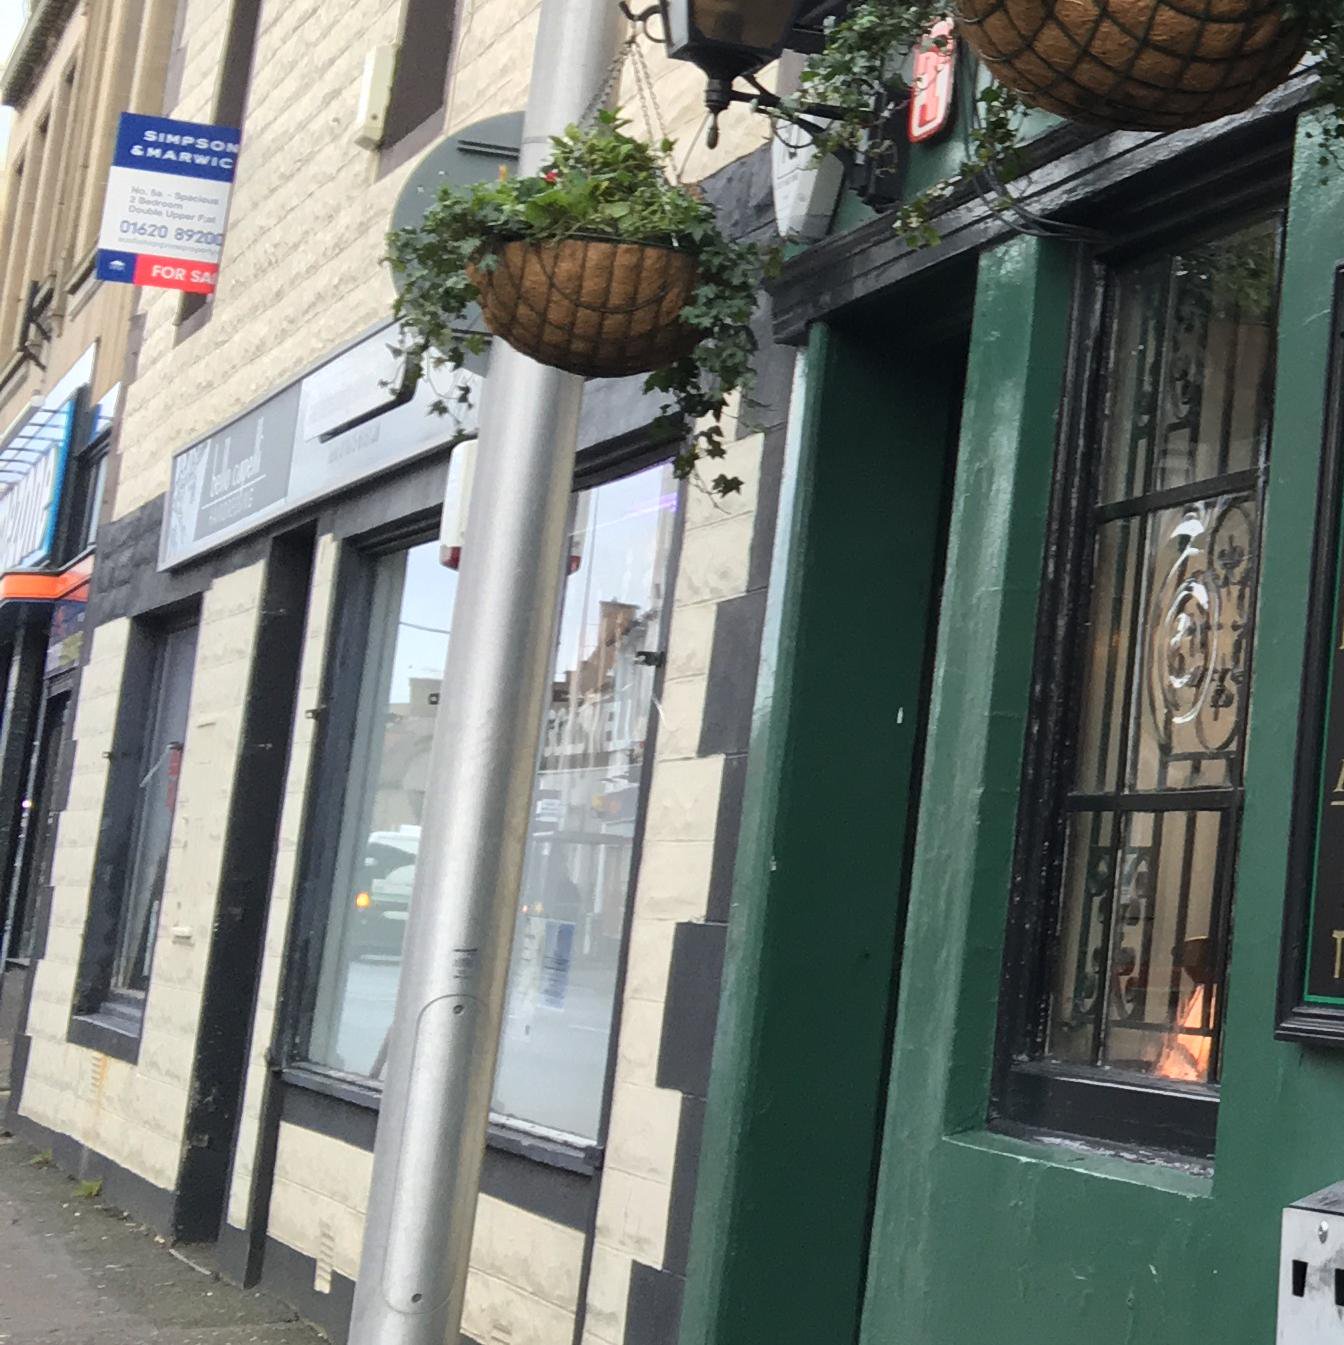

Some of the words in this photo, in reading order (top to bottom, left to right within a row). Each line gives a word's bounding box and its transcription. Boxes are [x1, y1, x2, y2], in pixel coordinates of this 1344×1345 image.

[143, 130, 240, 154] SIMPSON
[138, 196, 184, 210] Bedroom
[174, 192, 220, 206] Spacious
[128, 205, 163, 217] Double
[165, 210, 196, 222] Upper
[119, 220, 169, 239] 01620
[151, 264, 186, 281] FOR
